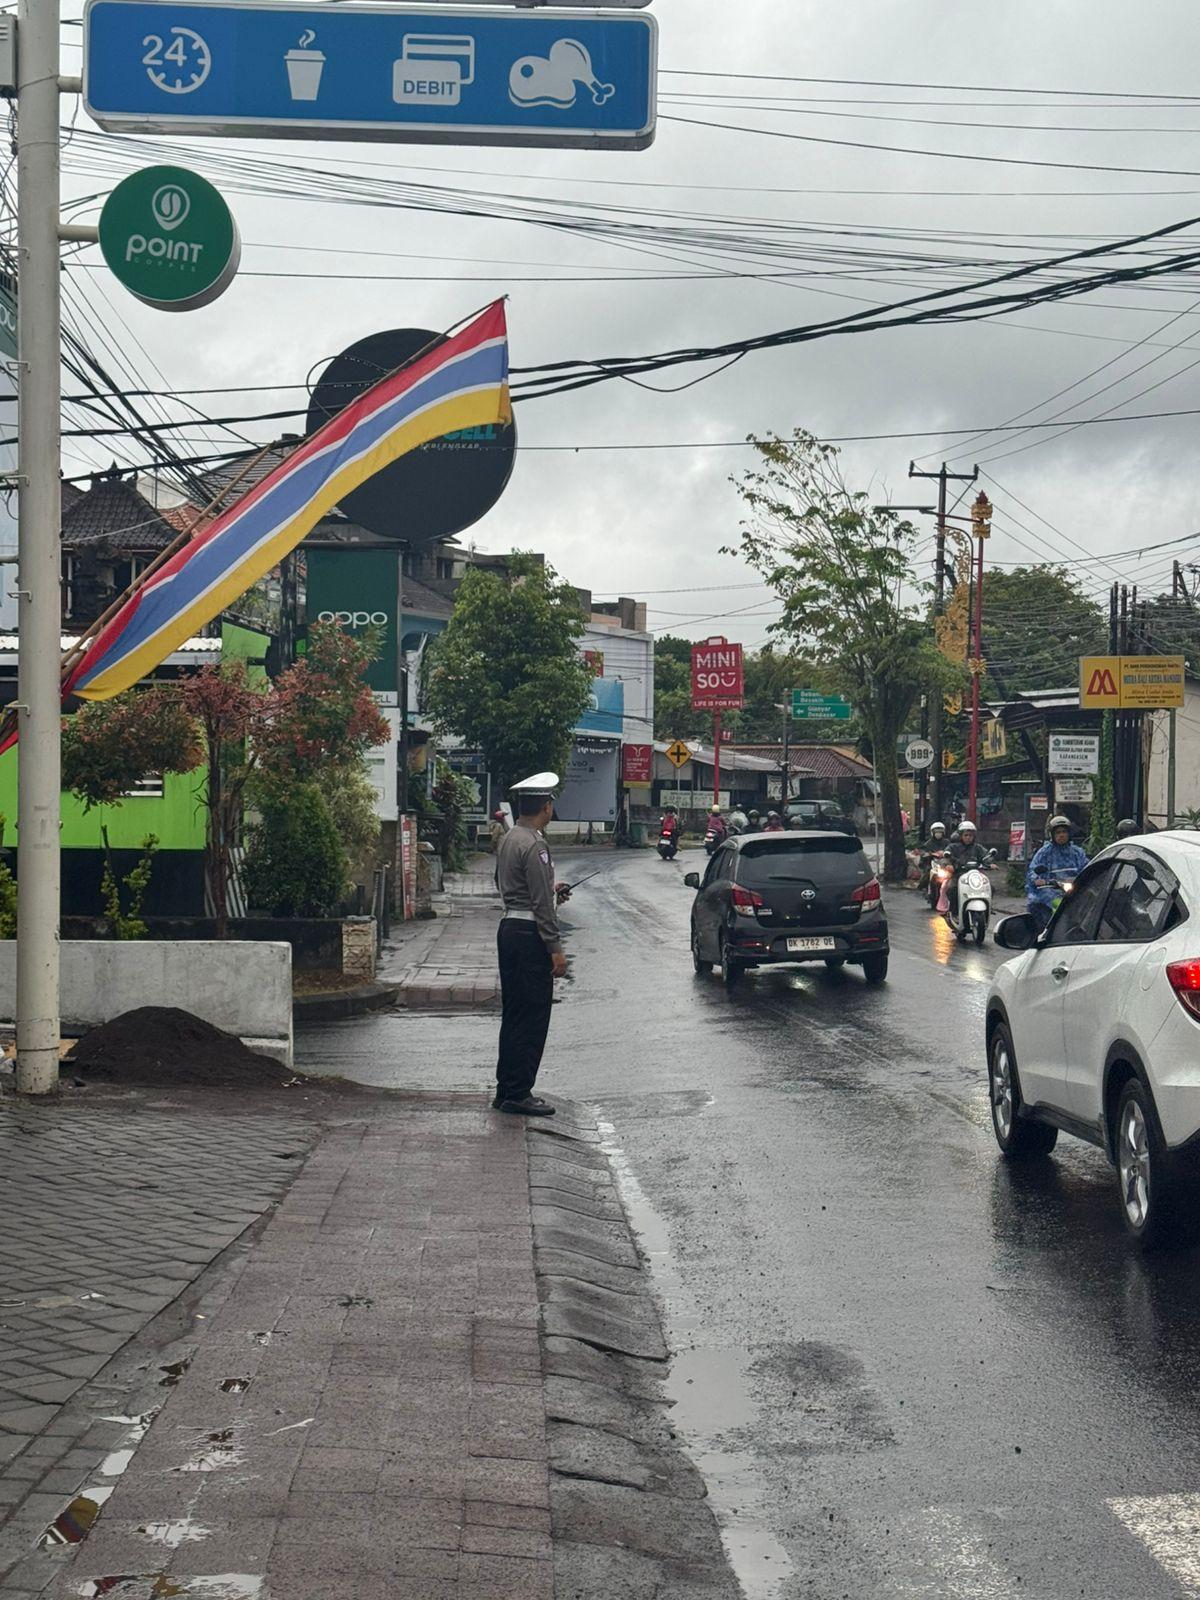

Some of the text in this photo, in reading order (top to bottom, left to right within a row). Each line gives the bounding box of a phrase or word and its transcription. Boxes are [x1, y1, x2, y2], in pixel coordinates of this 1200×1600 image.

[142, 34, 187, 67] 24
[403, 80, 457, 96] DEBIT
[696, 651, 736, 669] MINI
[788, 938, 798, 947] DK
[800, 938, 820, 947] 1782
